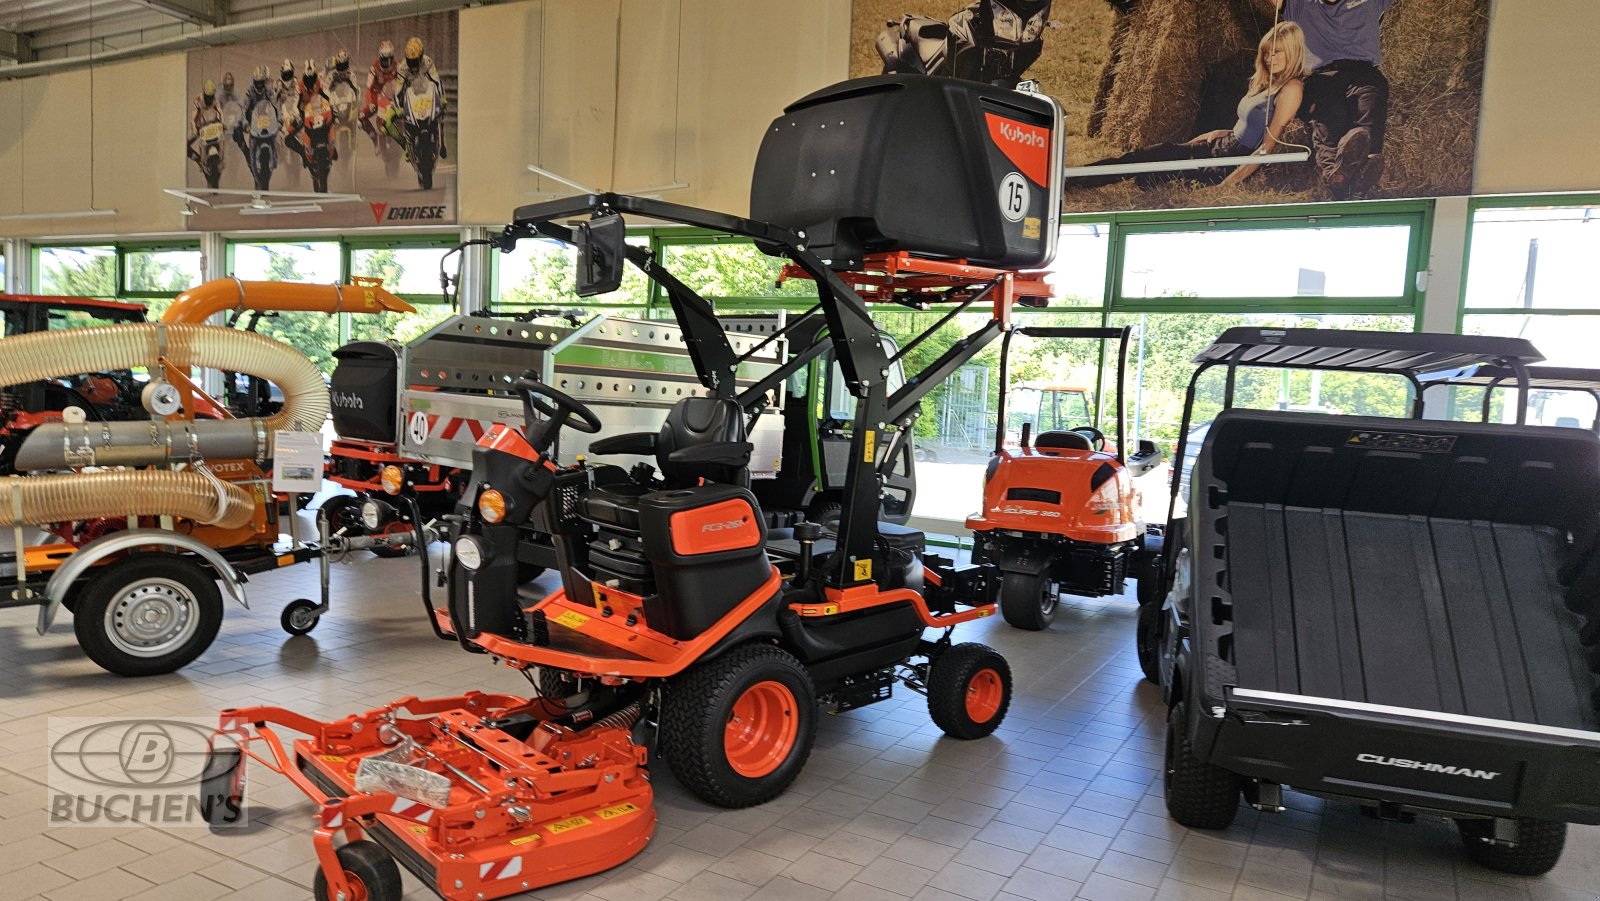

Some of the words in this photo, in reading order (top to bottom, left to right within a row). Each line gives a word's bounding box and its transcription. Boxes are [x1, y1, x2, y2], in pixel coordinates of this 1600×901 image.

[1000, 122, 1045, 148] Kubota
[1008, 181, 1024, 212] 15
[332, 391, 363, 409] Kubota
[413, 416, 425, 440] 40
[1356, 753, 1496, 779] CUSHMAN
